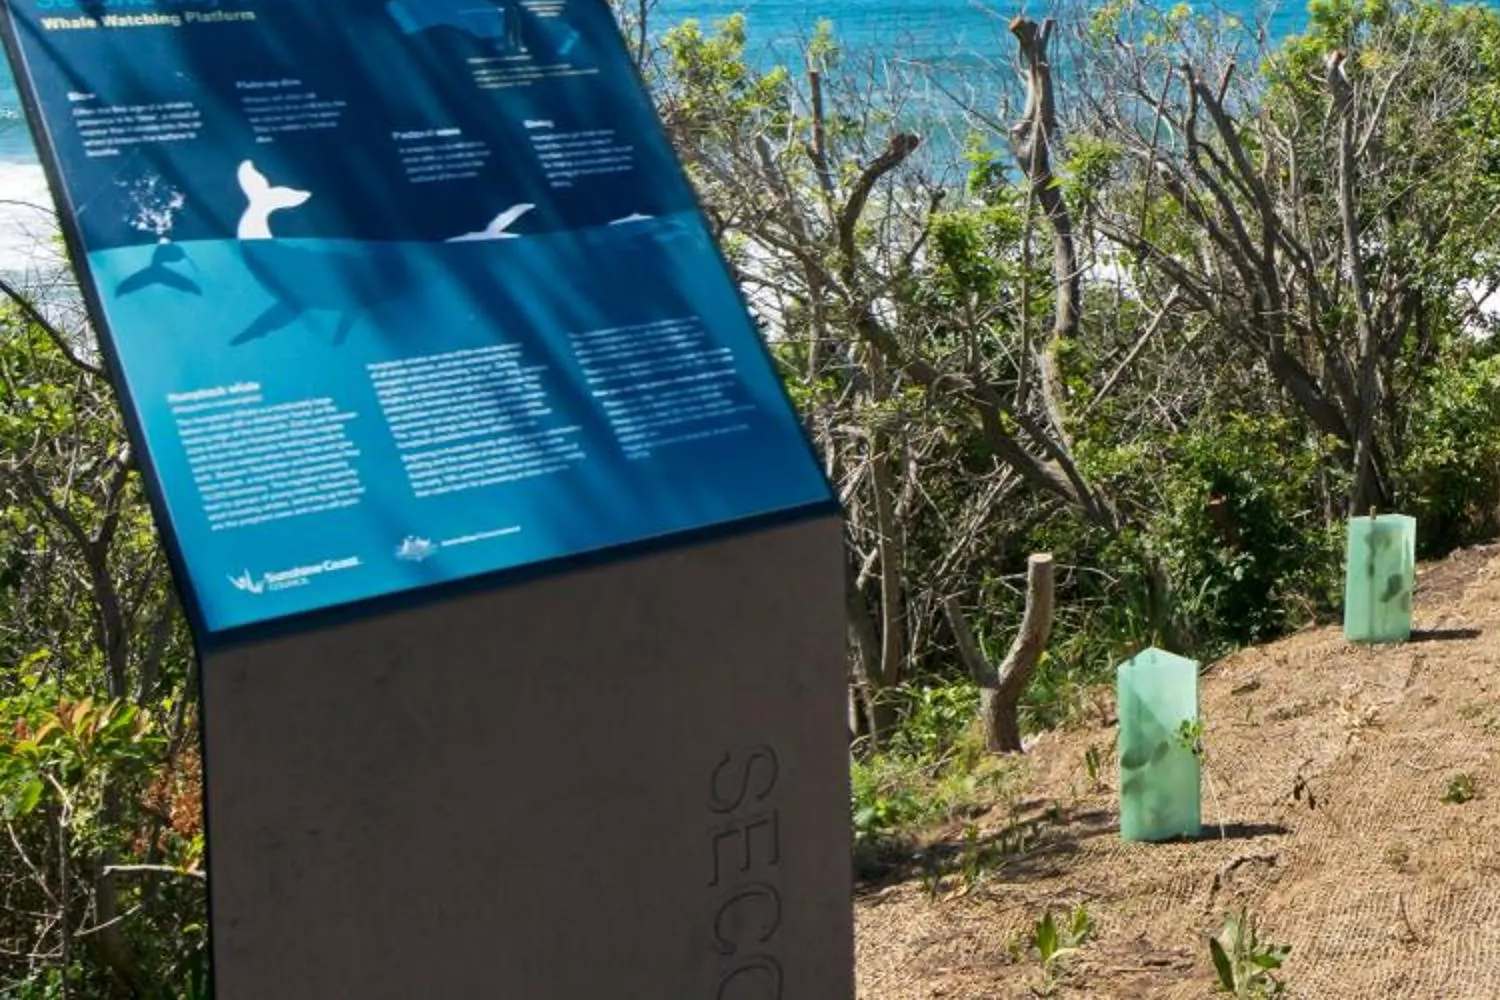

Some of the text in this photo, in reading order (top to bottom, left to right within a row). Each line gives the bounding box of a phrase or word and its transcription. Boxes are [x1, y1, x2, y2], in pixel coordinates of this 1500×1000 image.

[40, 10, 257, 30] Whale Watching Platform
